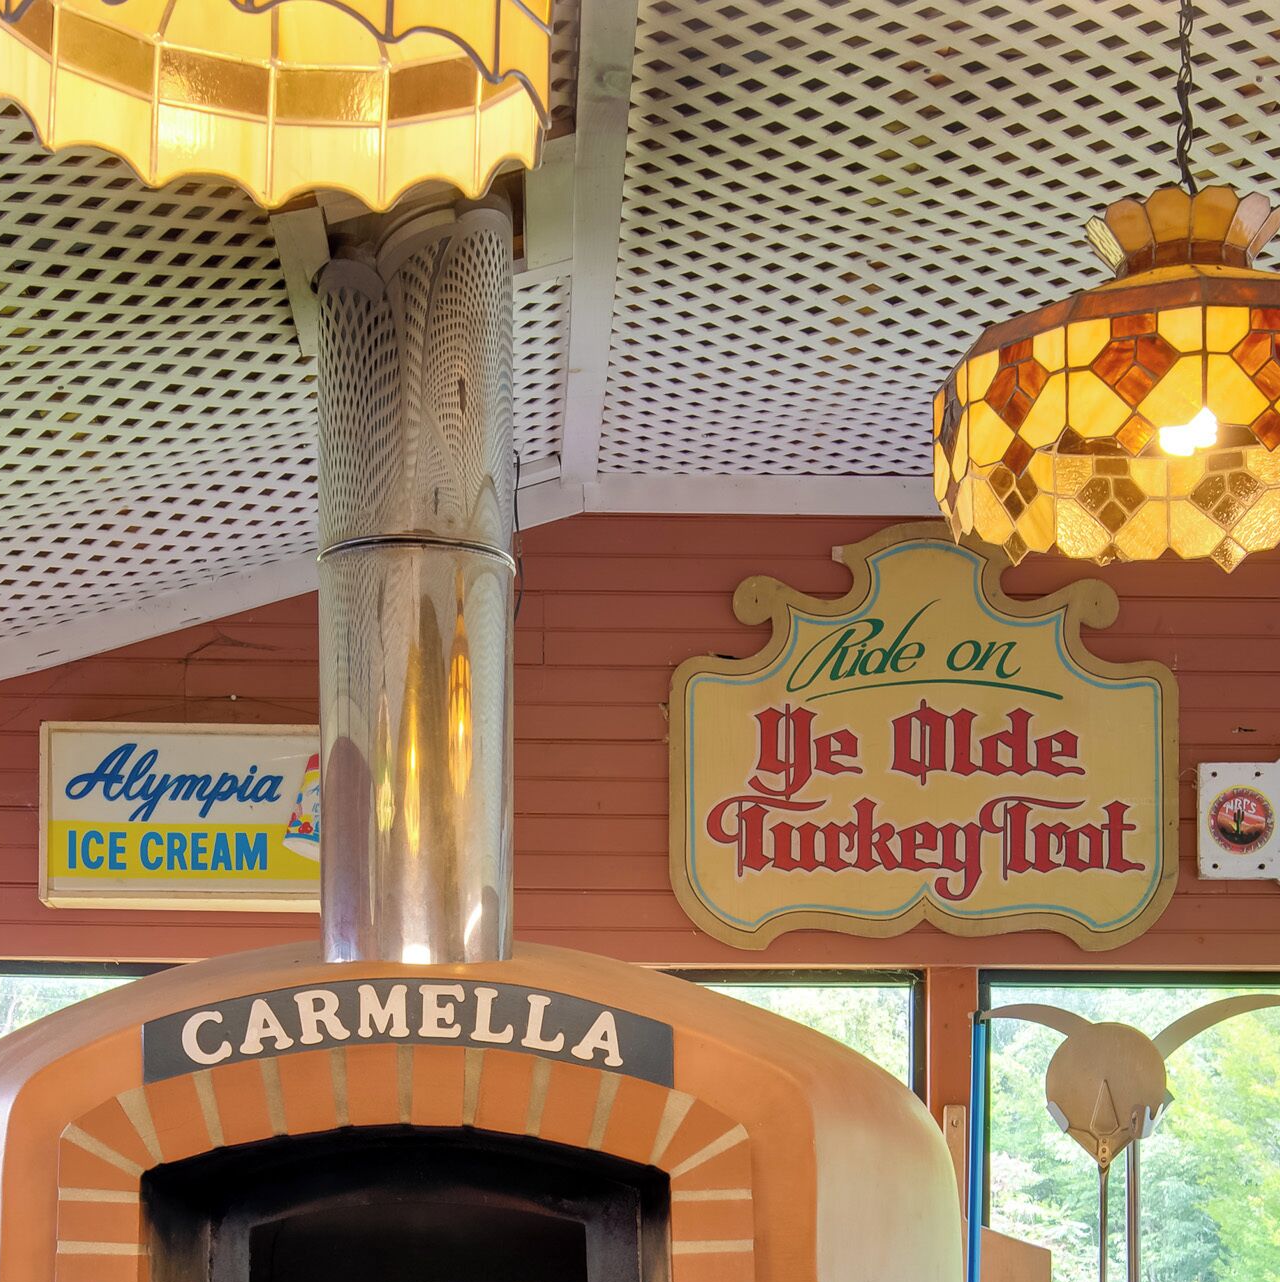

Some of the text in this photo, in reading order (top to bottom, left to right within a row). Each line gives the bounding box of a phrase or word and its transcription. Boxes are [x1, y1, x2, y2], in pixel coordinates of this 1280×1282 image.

[787, 599, 1020, 692] Ride on
[65, 742, 284, 822] Alympia
[748, 699, 1086, 800] Ye Olde
[67, 830, 269, 871] ICE CREAM
[706, 795, 1145, 900] Turkey Trot
[181, 983, 624, 1068] CARMELLA
